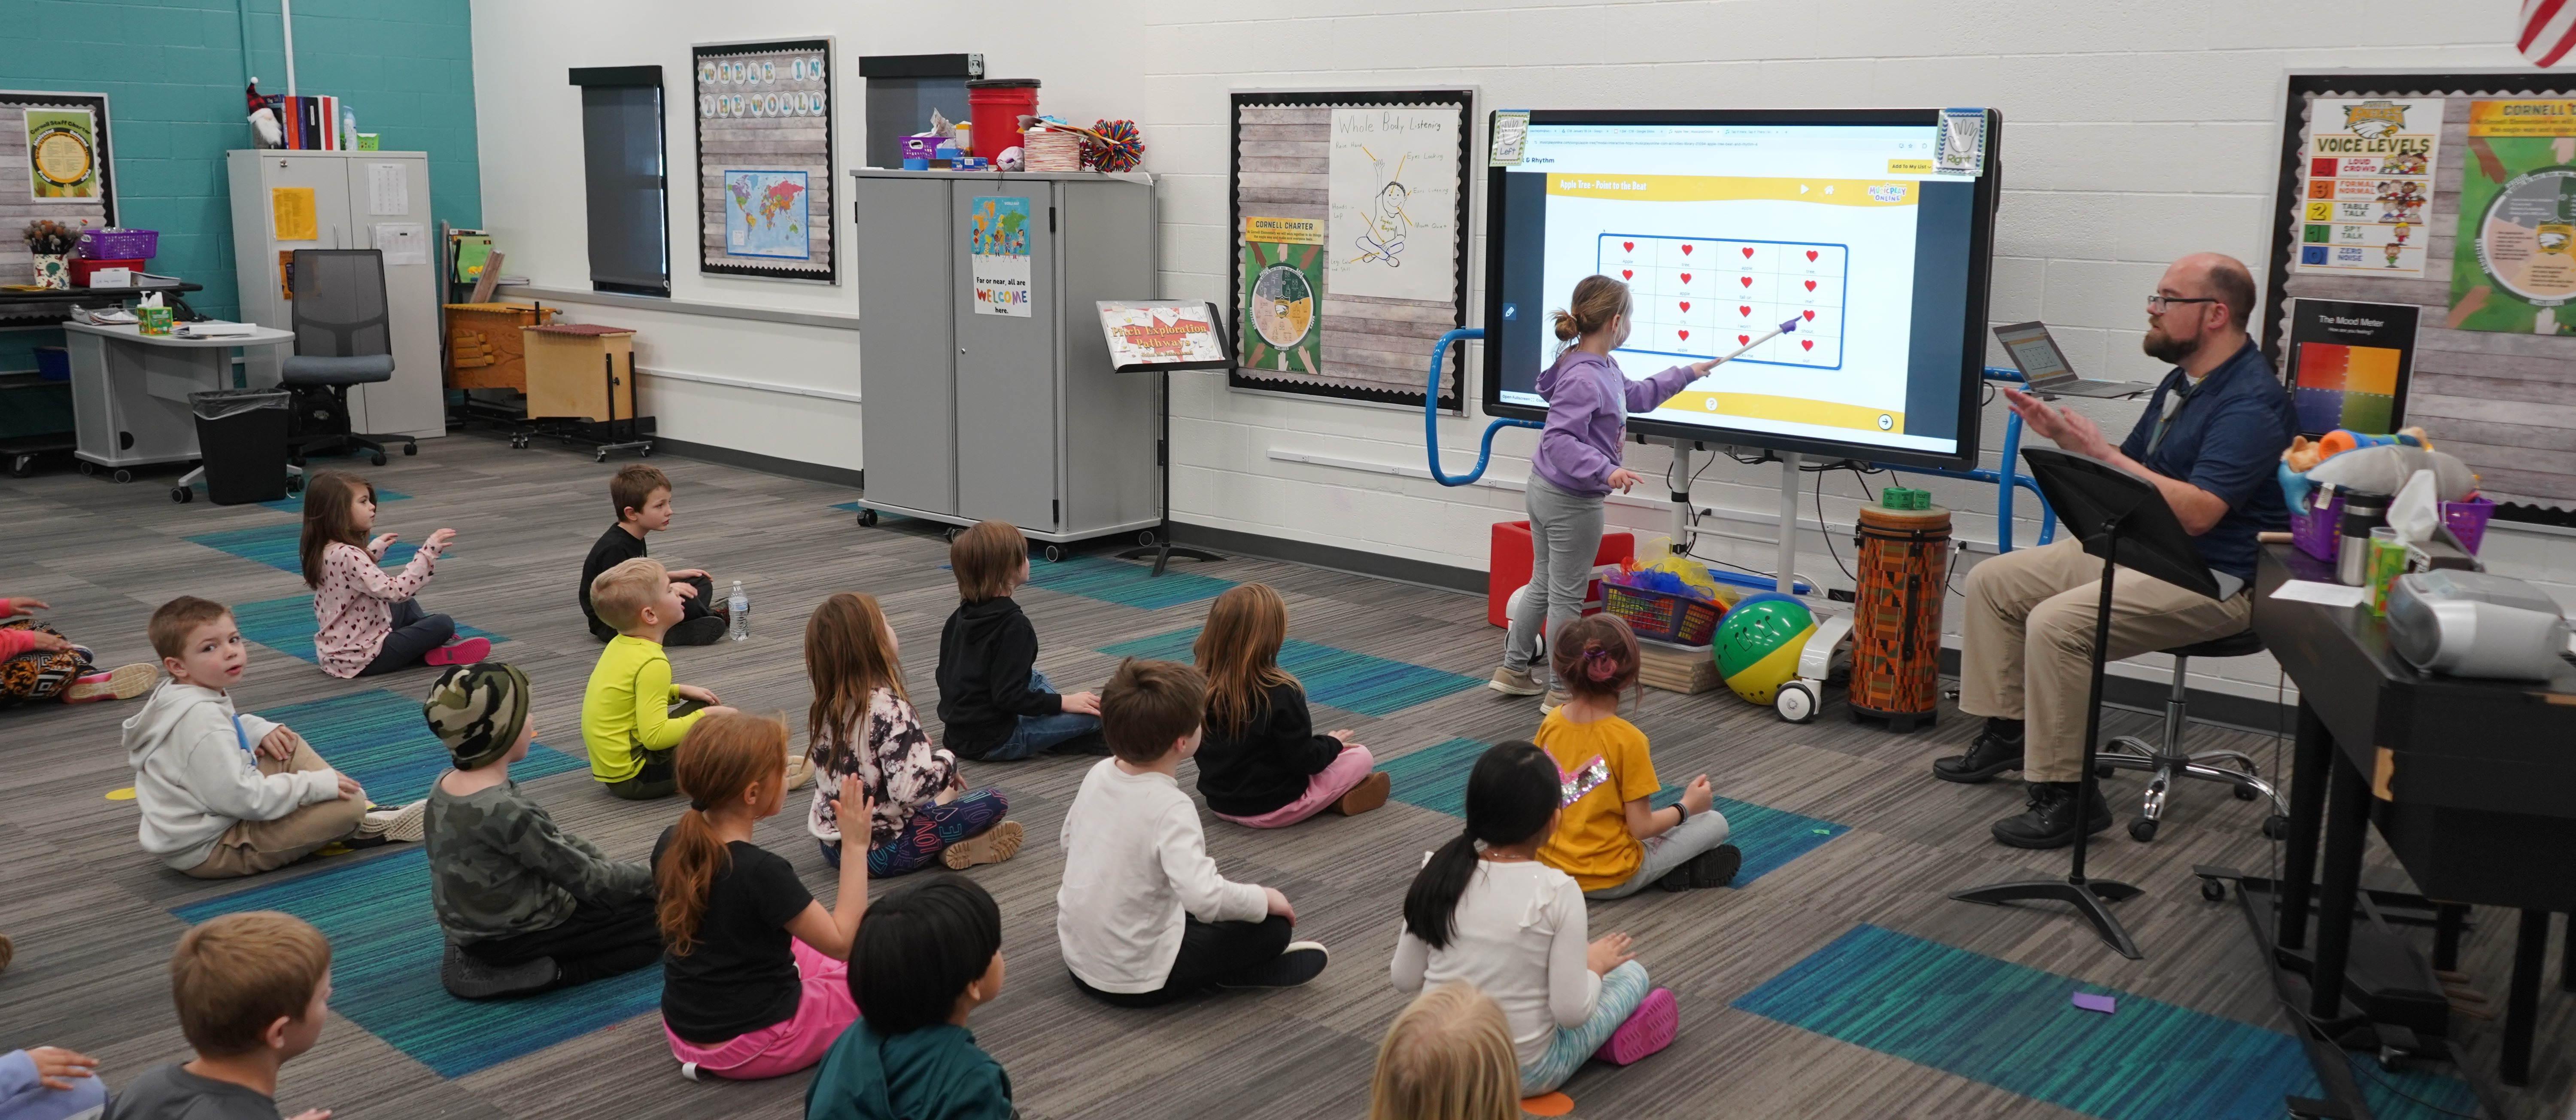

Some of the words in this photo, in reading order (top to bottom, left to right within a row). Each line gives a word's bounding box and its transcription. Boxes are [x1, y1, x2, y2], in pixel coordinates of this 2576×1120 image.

[703, 64, 773, 81] WHERE
[795, 61, 820, 79] IN
[704, 97, 743, 114] THE
[751, 94, 822, 112] WORLD
[2503, 105, 2564, 116] CORNELL
[30, 121, 50, 134] Cornell
[68, 121, 91, 134] Charter
[1338, 114, 1374, 134] Whole
[1382, 111, 1404, 134] Body
[1410, 117, 1441, 131] Listening
[33, 128, 55, 146] Motivated
[1336, 141, 1347, 149] Raise
[1500, 147, 1516, 155] Left
[2318, 138, 2363, 152] VOICE
[2367, 138, 2430, 153] LEVELS
[1406, 151, 1420, 161] Eyes
[1424, 152, 1443, 161] Looking
[2315, 158, 2332, 177] 4
[1560, 180, 1577, 190] Apple
[1577, 180, 1591, 189] Tree
[1596, 180, 1611, 189] Point
[1621, 181, 1631, 190] the
[1632, 181, 1647, 191] Beat
[1869, 186, 1906, 195] MUSICPLAY
[2315, 180, 2329, 199] 3
[2311, 203, 2327, 221] 2
[1285, 222, 1313, 230] CHARTER
[1296, 268, 1304, 276] SAFE
[976, 287, 1028, 305] WELCOME
[2318, 315, 2335, 323] The
[2336, 317, 2359, 326] Mood
[2360, 318, 2385, 327] Meter
[1111, 326, 1141, 337] Pitch
[1145, 324, 1207, 338] Exploration
[1135, 338, 1191, 349] Pathways
